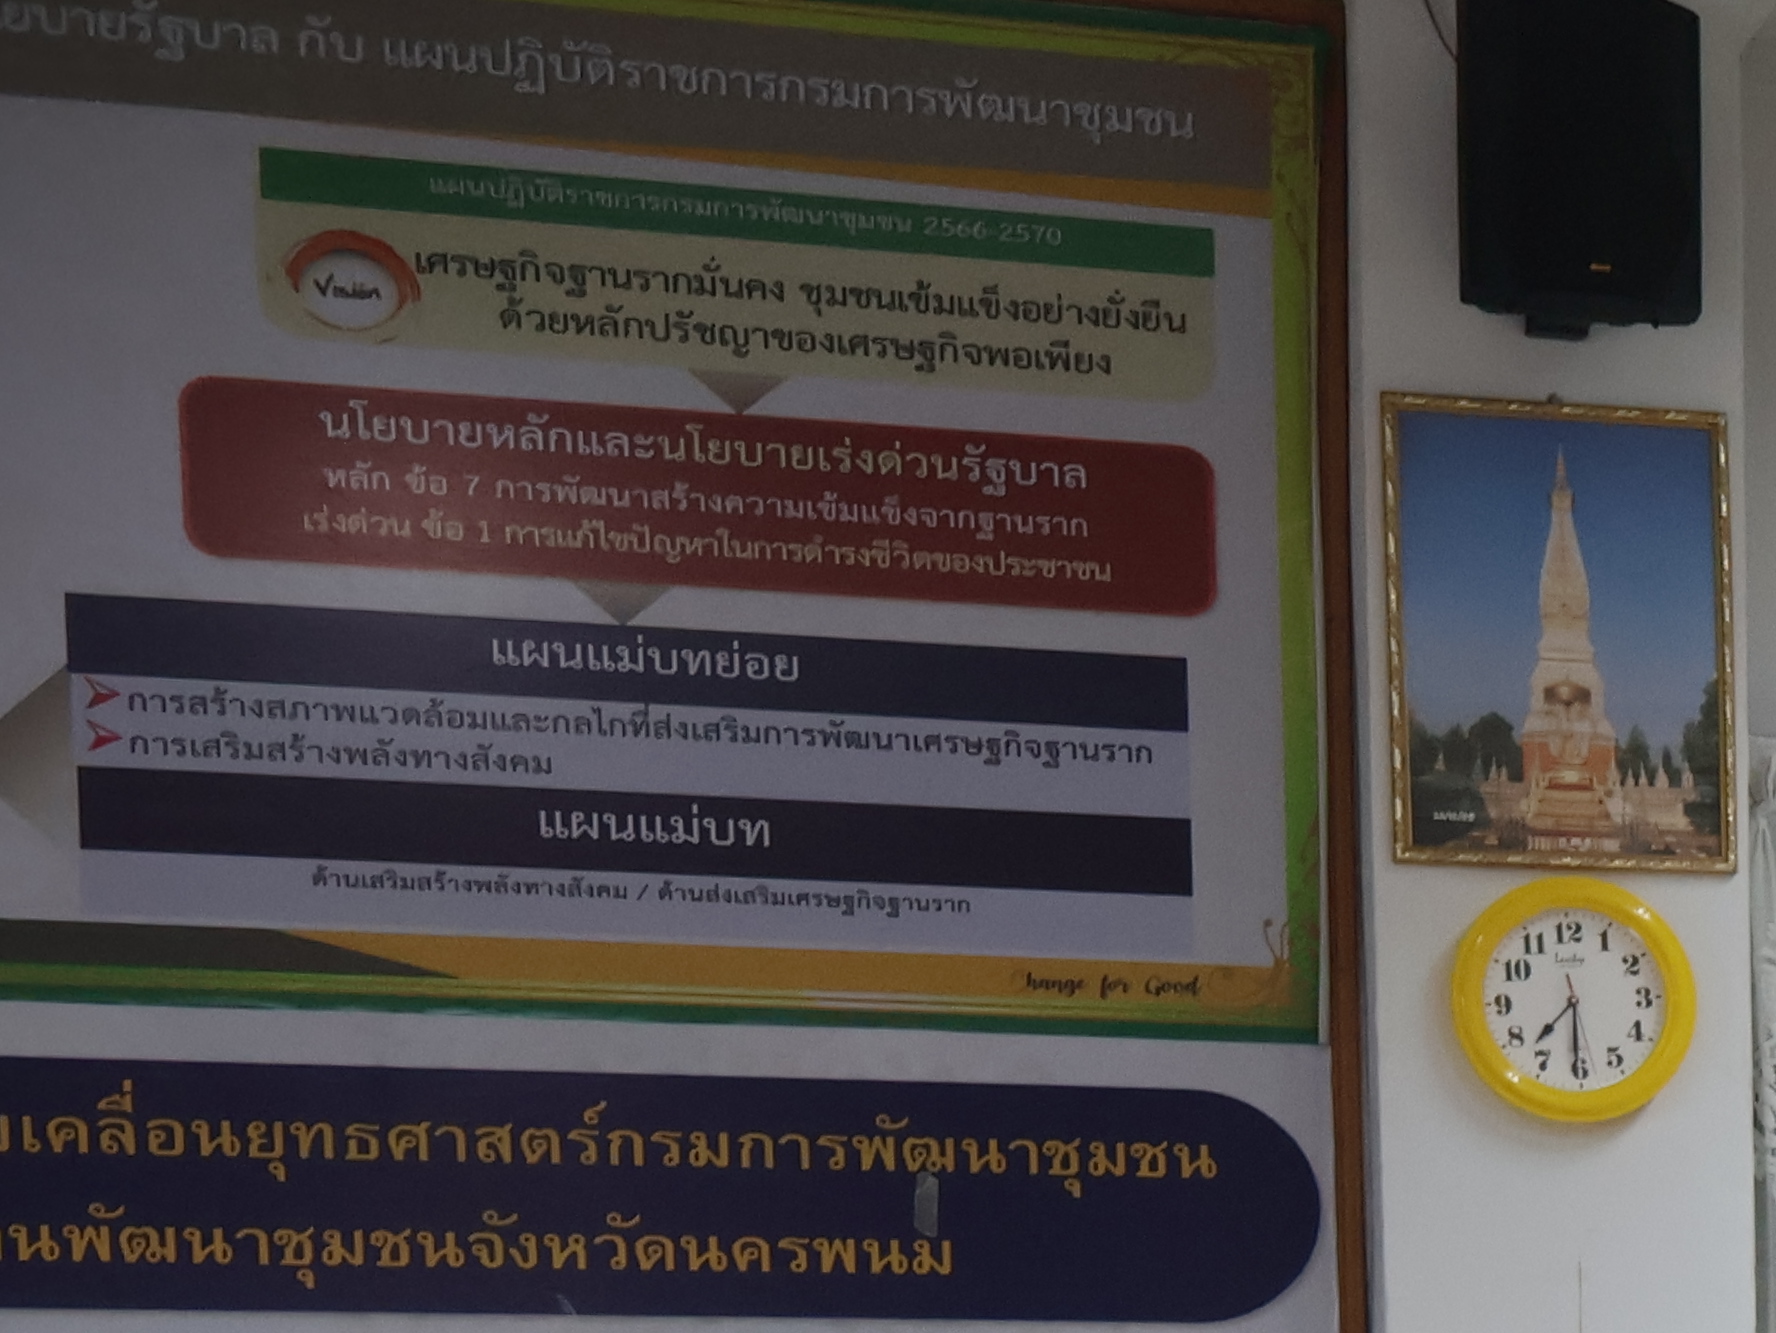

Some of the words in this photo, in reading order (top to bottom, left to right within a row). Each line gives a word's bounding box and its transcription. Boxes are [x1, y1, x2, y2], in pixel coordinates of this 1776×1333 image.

[297, 15, 365, 62] กับ
[383, 38, 1196, 145] แผนปฏิบัติราชการกรมการพัฒนาชุมชน
[414, 248, 785, 304] เศรษฐกิจฐานรากมั่นคง
[798, 274, 1187, 336] ชุมชนเข้มแข็งอย่างยั่งยืน
[499, 299, 1113, 377] ด้วยหลักปรัชญาของเศรษฐกิจพอเพียง
[319, 399, 1088, 496] นโยบายหลักและนโยบายเร่งด่วนรัฐบาล
[323, 462, 391, 494] หลัก
[405, 466, 448, 497] ข้อ
[463, 472, 479, 495] 7
[303, 503, 411, 540] เร่งด่วน
[421, 511, 465, 543] ข้อ
[476, 517, 489, 544] 1
[491, 632, 800, 683] แผนแม่บทย่อย
[129, 731, 553, 776] การเสริมสร้างพลังทางสังคม
[538, 804, 771, 849] แผนแม่บท
[1521, 933, 1546, 956] 11
[1554, 921, 1583, 945] 12
[1597, 928, 1611, 953] 1
[1503, 957, 1532, 983] 10
[1622, 955, 1641, 977] 2
[1494, 994, 1513, 1017] 9
[1635, 986, 1653, 1010] 3
[1507, 1025, 1525, 1047] 8
[1627, 1019, 1645, 1042] 4
[1533, 1049, 1552, 1073] 7
[1606, 1047, 1624, 1069] 5
